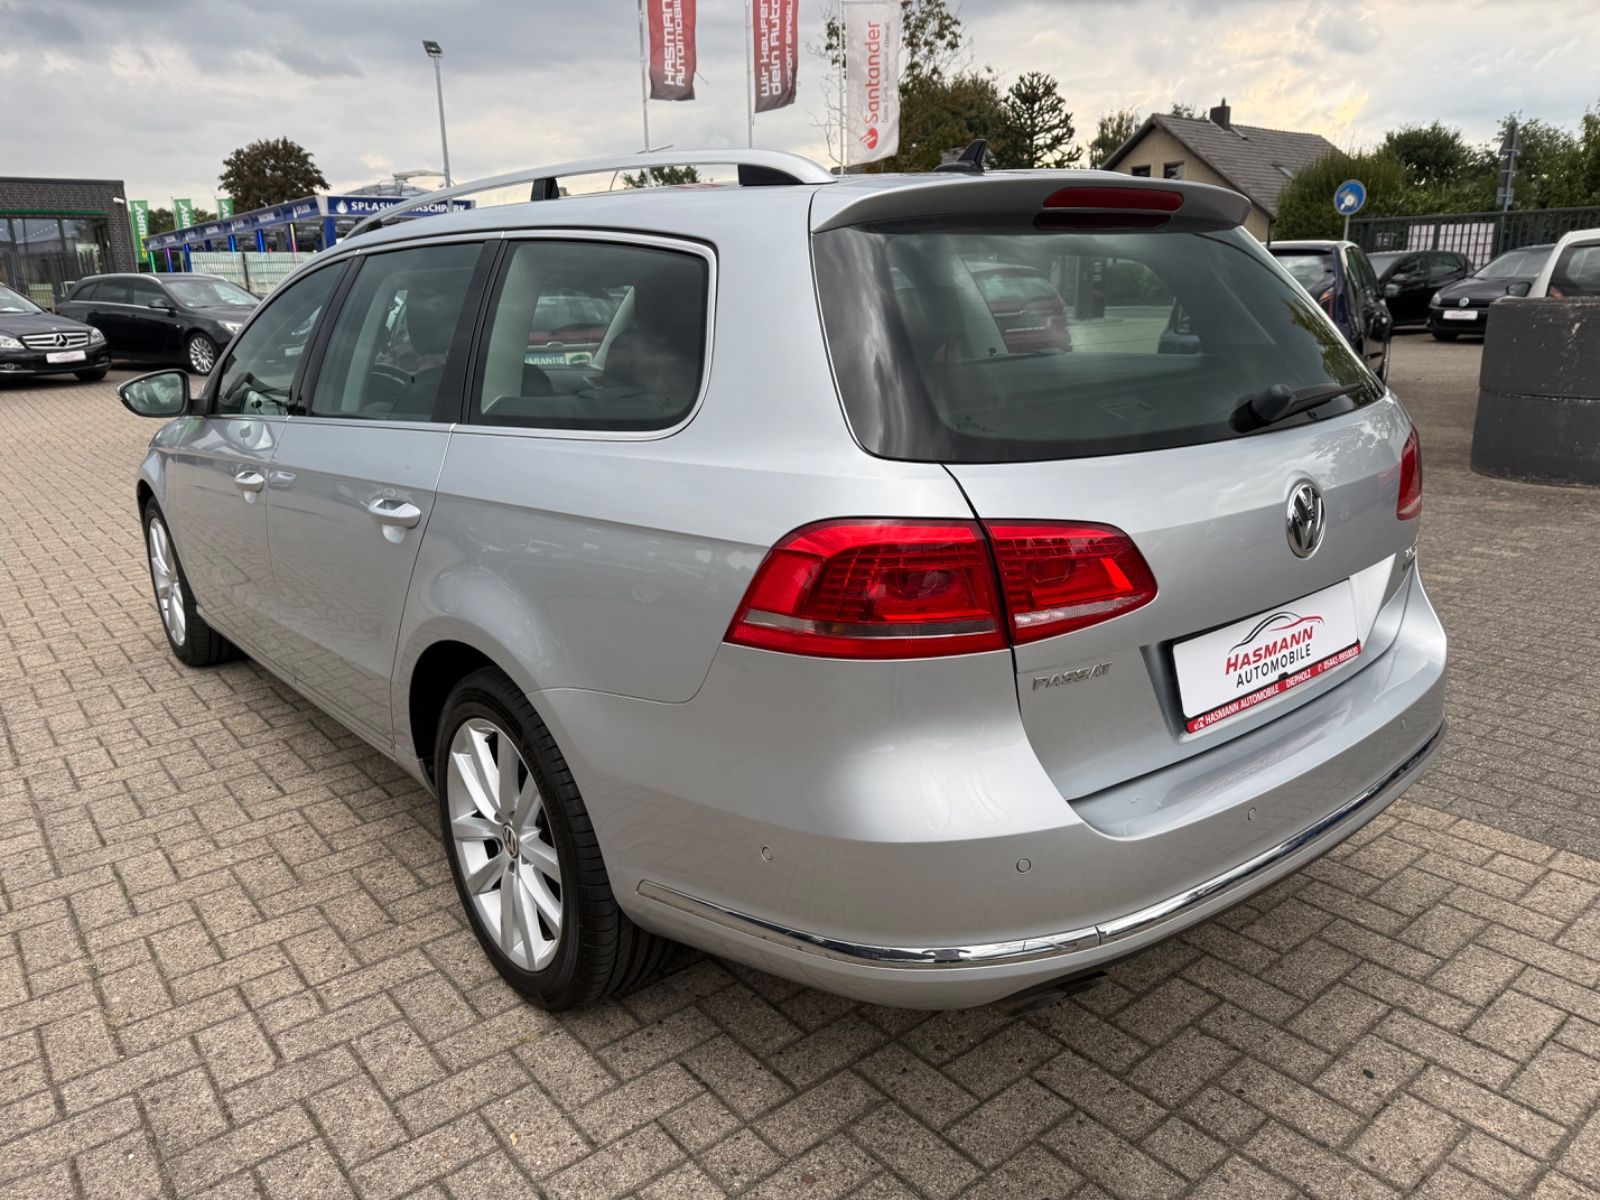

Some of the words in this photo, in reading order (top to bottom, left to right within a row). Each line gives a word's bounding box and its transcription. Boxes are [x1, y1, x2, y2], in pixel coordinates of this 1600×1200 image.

[761, 67, 769, 97] Wir
[769, 51, 781, 95] dein
[864, 21, 880, 124] Santander
[411, 203, 466, 213] ASCHPRK
[1225, 626, 1313, 675] HASMANN
[1236, 643, 1311, 688] AUTOMOBILE
[1032, 661, 1113, 690] PASSAT
[1204, 702, 1240, 725] HASMANN
[1240, 684, 1280, 709] AUTOMOBILE
[1285, 669, 1311, 688] DIEPHOLZ
